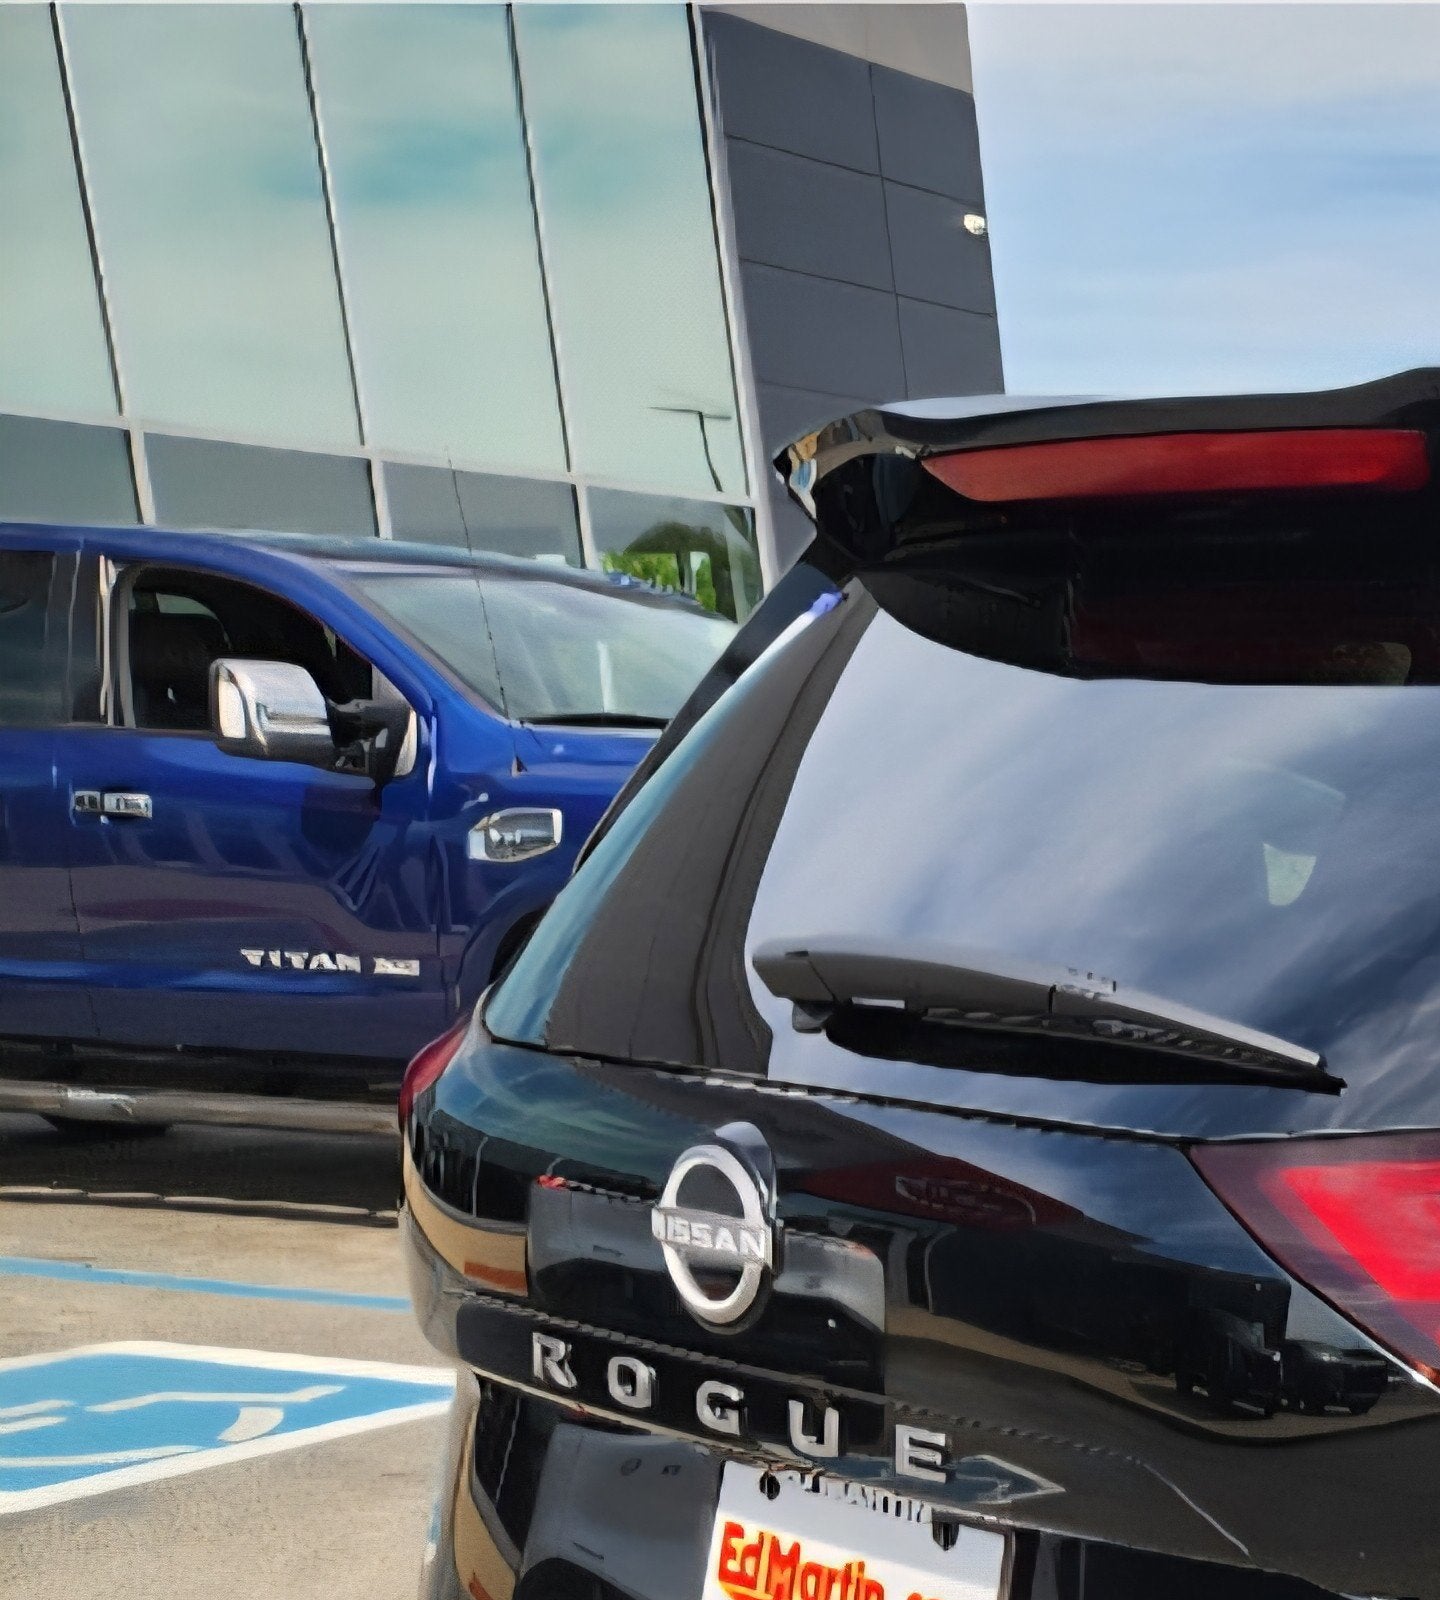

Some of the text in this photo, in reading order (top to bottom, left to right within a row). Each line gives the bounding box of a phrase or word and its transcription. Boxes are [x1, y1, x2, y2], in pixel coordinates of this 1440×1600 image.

[240, 948, 362, 974] TITAN
[651, 1207, 767, 1260] NISSAN
[531, 1331, 951, 1484] ROGUE
